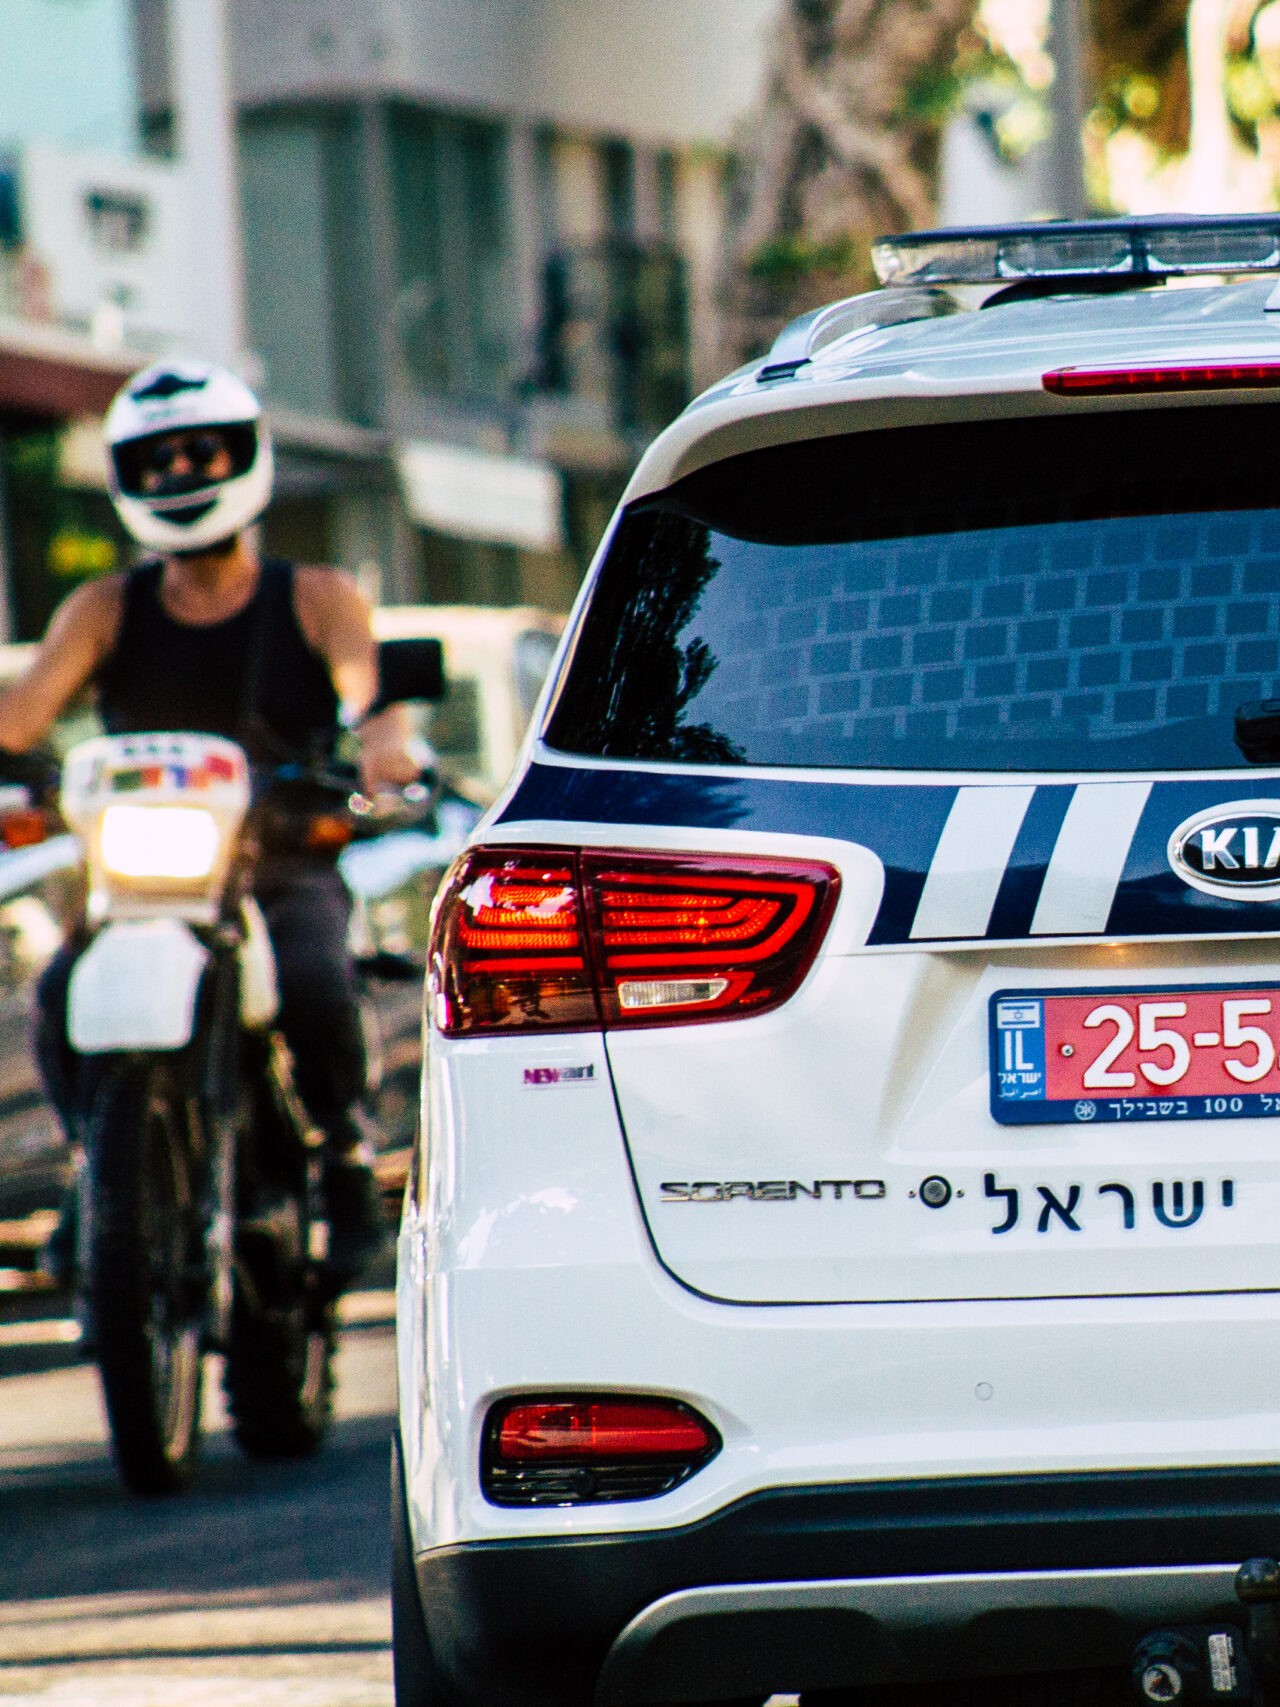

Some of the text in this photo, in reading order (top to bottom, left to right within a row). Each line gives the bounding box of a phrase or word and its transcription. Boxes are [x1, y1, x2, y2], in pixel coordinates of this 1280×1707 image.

[1003, 1030, 1035, 1071] IL
[997, 1072, 1042, 1084] ישראל
[1109, 1099, 1189, 1119] בשבילך
[1204, 1097, 1243, 1114] 100
[660, 1179, 886, 1202] SORENTO
[984, 1172, 1234, 1234] ישראל
